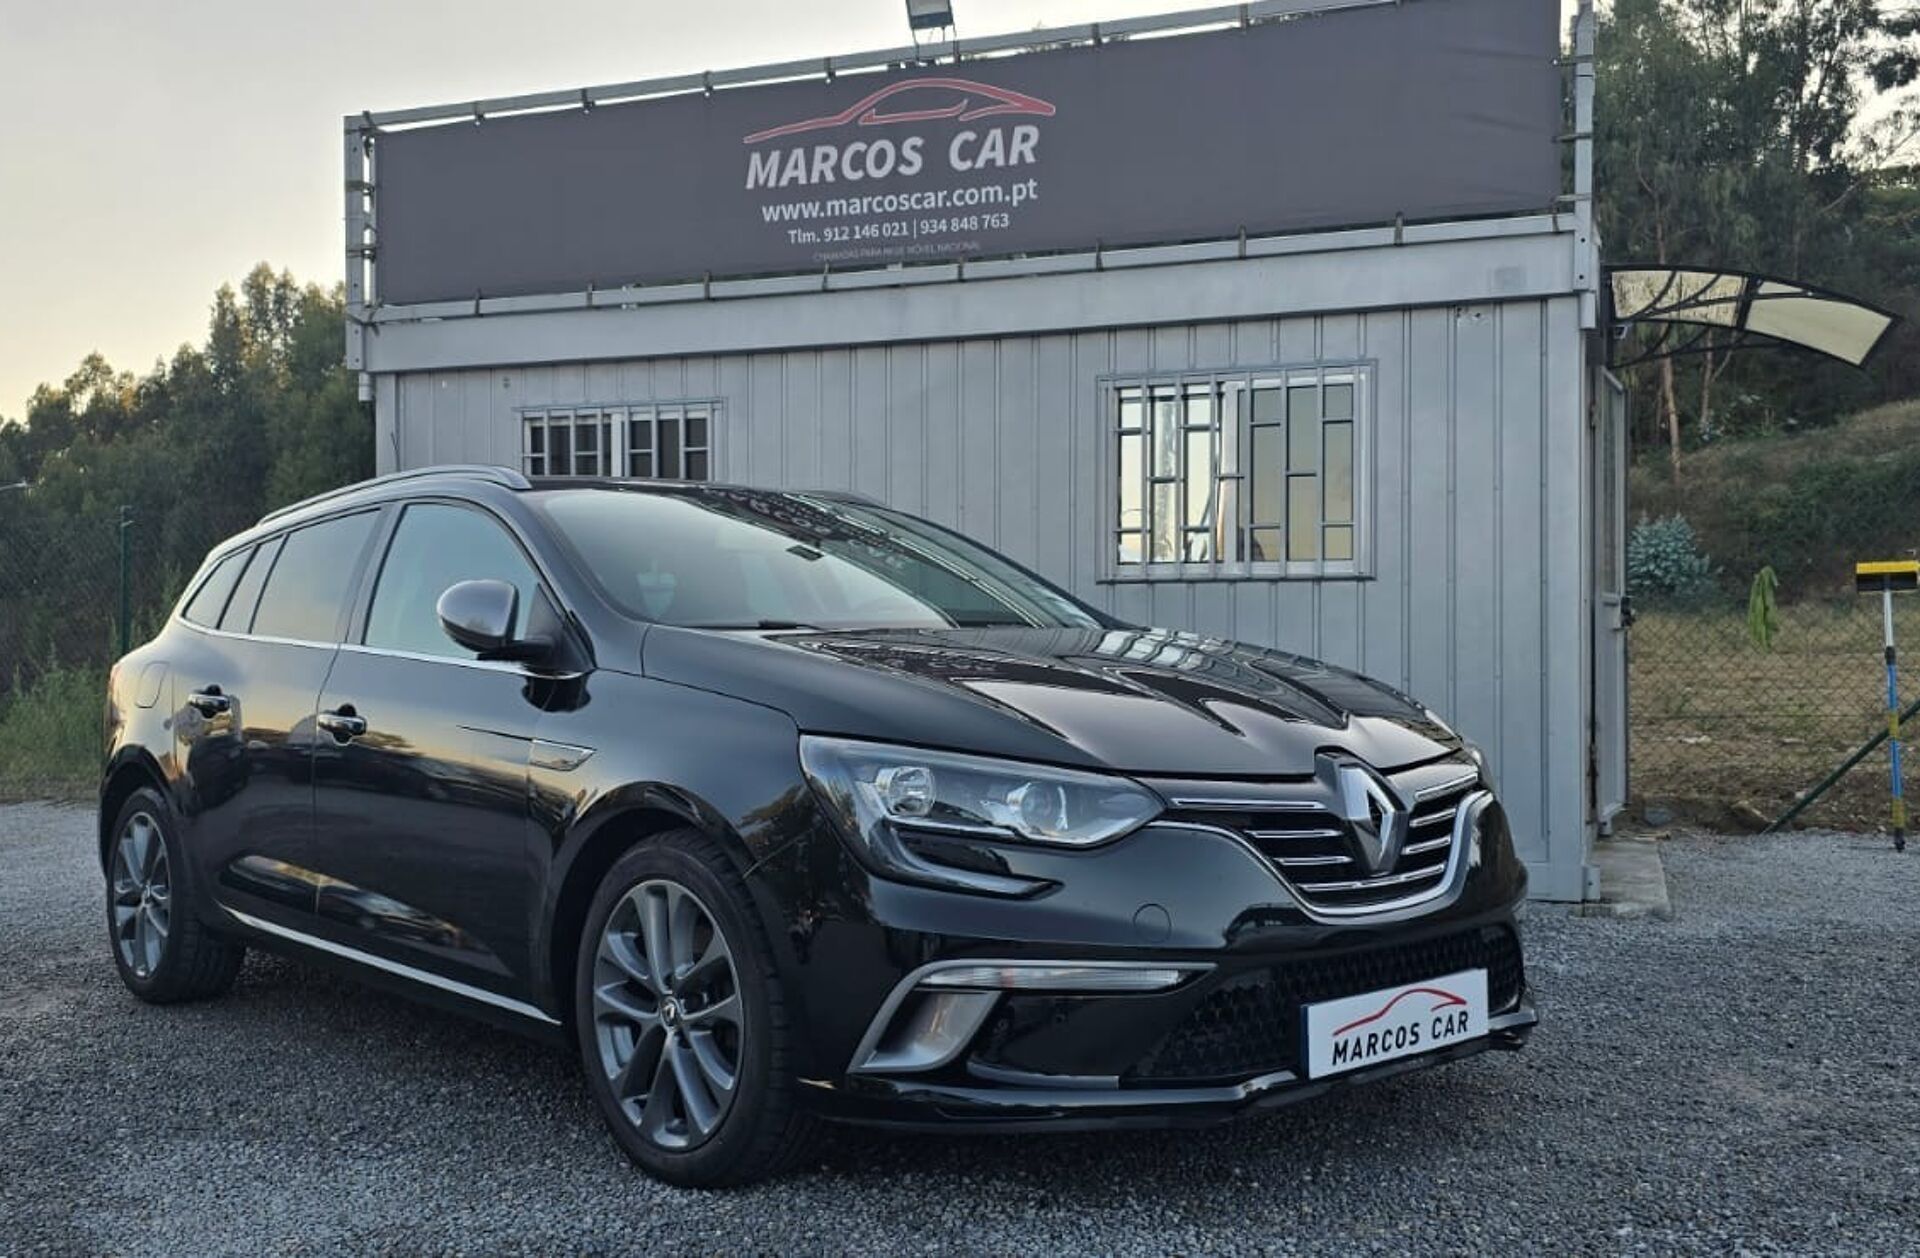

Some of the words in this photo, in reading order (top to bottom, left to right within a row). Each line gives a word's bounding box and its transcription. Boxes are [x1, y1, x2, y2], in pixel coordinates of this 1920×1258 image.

[746, 136, 924, 189] MARCOS
[950, 125, 1040, 170] CAR
[761, 178, 1038, 222] www.marcoscar.com.pt
[788, 227, 821, 244] Tlm.
[824, 225, 849, 241] 912
[853, 223, 879, 238] 146
[882, 221, 909, 237] 021
[920, 217, 947, 233] 934
[950, 214, 977, 231] 848
[981, 212, 1010, 228] 763
[1332, 1022, 1421, 1065] MARCOS
[1431, 1011, 1469, 1040] CAR
